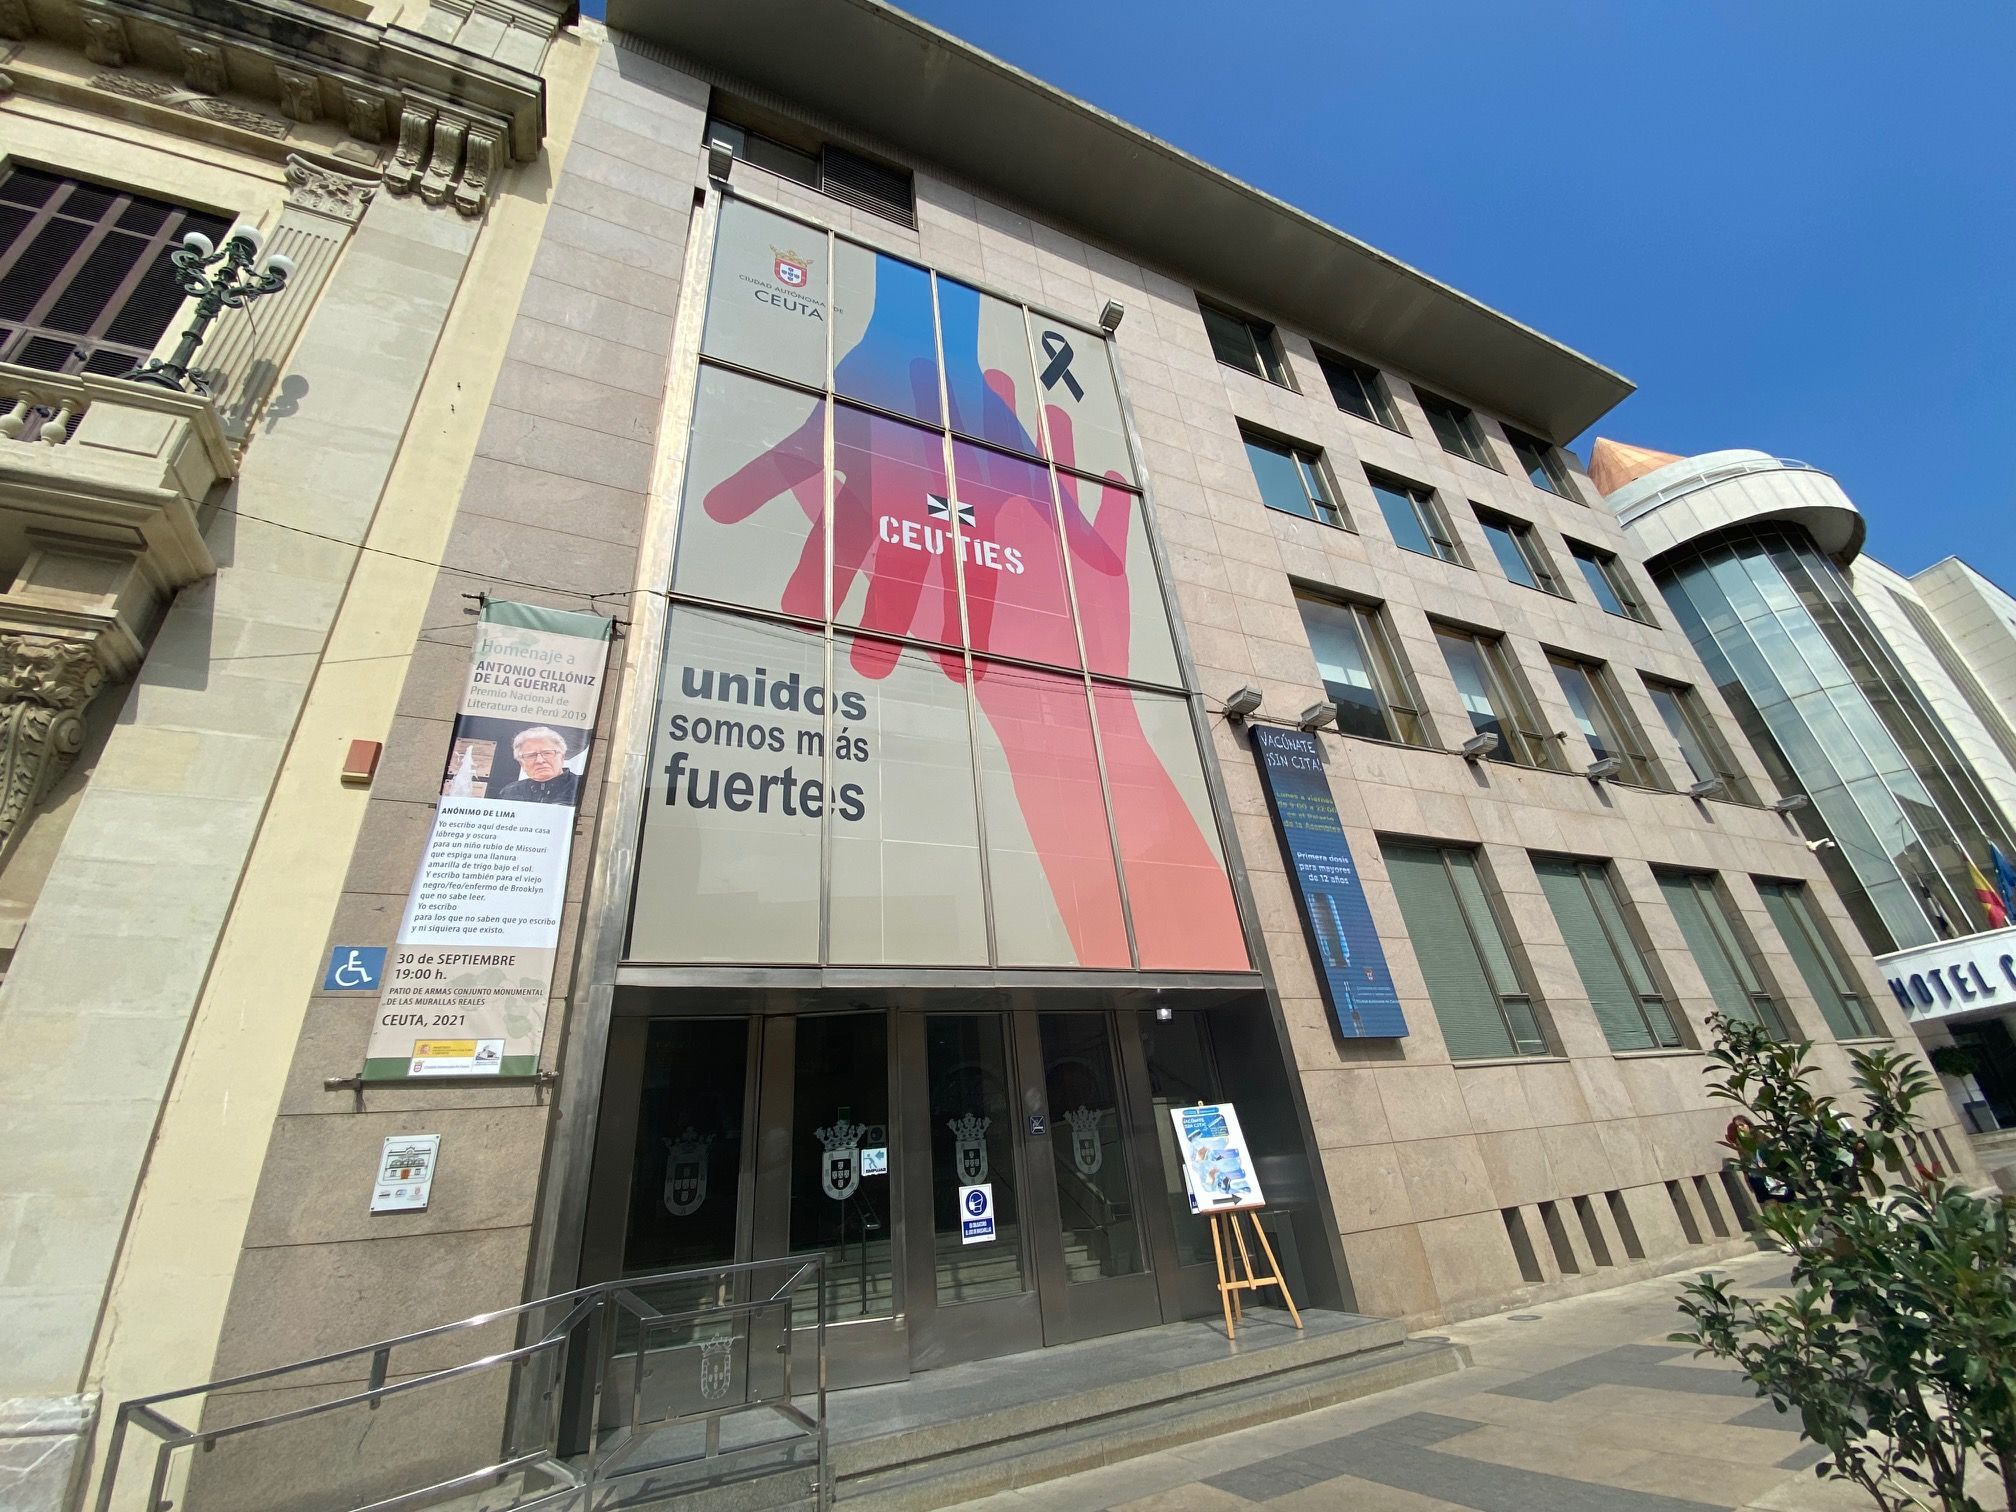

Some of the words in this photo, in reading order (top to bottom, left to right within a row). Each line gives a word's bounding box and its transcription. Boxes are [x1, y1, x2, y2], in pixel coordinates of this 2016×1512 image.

[739, 274, 772, 289] CIUDAD
[774, 286, 826, 307] AUTÓNOMA
[754, 290, 823, 321] CEUTA
[482, 638, 563, 664] Homenaje
[566, 654, 575, 664] a
[476, 661, 536, 677] ANTONIO
[540, 669, 596, 686] CILLÓNIZ
[473, 673, 491, 683] DE
[495, 675, 510, 686] LA
[514, 677, 566, 693] GUERRA
[471, 686, 507, 698] Premio
[510, 690, 554, 704] Nacional
[556, 697, 569, 706] de
[681, 666, 867, 721] unidos
[467, 699, 517, 713] Literatura
[520, 705, 533, 714] de
[536, 707, 558, 717] Perú
[561, 710, 587, 720] 2019
[669, 714, 785, 752] somos
[797, 727, 869, 762] más
[1260, 732, 1316, 754] VACÚNATE
[1267, 752, 1288, 767] ¡SIN
[1291, 756, 1322, 771] CITA!
[664, 751, 865, 821] fuertes
[441, 807, 481, 816] ANÓNIMO
[495, 810, 515, 818] LIMA
[516, 845, 547, 853] Missouri
[490, 853, 517, 861] llanura
[1296, 851, 1327, 861] Primera
[1329, 853, 1349, 863] dosis
[474, 863, 491, 871] trigo
[494, 864, 510, 872] bajo
[1299, 863, 1317, 872] para
[1319, 865, 1351, 874] mayores
[462, 872, 494, 880] también
[496, 874, 513, 882] para
[1309, 873, 1318, 881] de
[1320, 873, 1329, 881] 12
[1331, 874, 1349, 884] años
[423, 882, 497, 891] negro/feo/enfermo
[511, 886, 544, 894] Brooklyn
[469, 893, 486, 901] leer.
[414, 914, 432, 922] para
[411, 925, 417, 933] y
[428, 924, 460, 934] siquiera
[397, 953, 414, 964] 30
[418, 954, 434, 964] de
[437, 954, 516, 966] SEPTIEMBRE
[395, 968, 431, 980] 19:00
[435, 968, 447, 980] h.
[389, 987, 410, 995] PATIO
[1888, 961, 1996, 1016] HOTEL
[382, 1014, 428, 1027] CEUTA,
[433, 1015, 465, 1026] 2021
